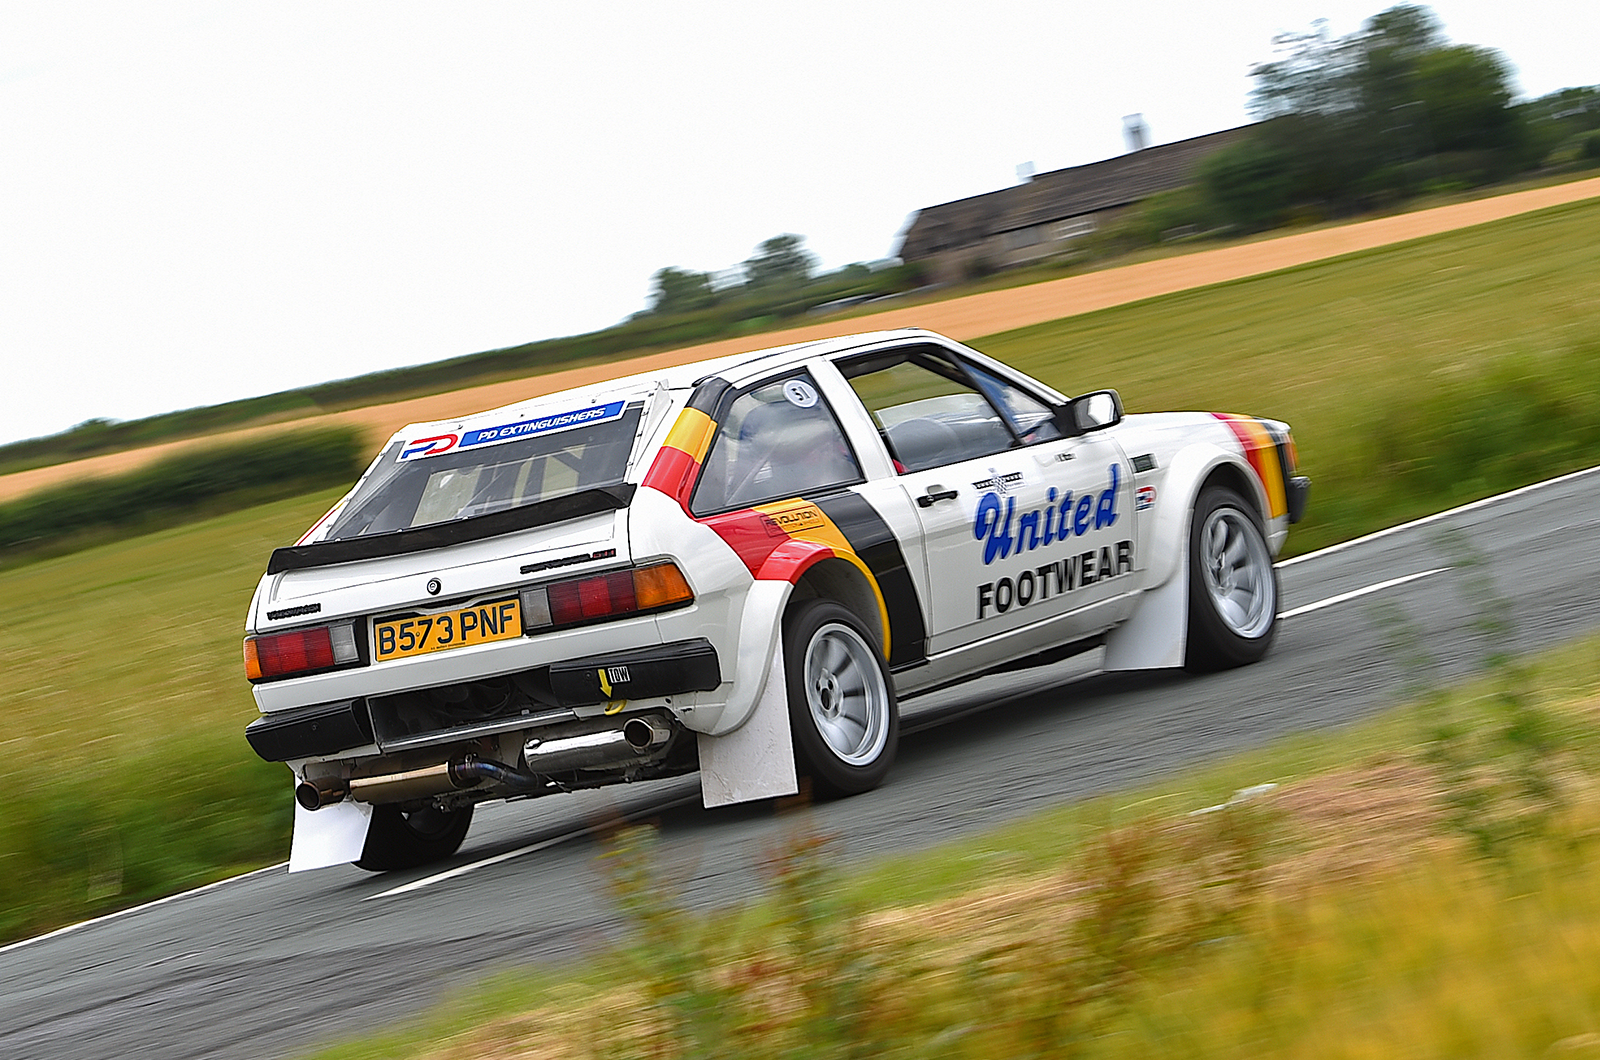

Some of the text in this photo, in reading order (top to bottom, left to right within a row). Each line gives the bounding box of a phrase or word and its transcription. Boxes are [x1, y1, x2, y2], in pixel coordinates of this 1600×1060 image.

[477, 407, 607, 442] PD EXTINGUISHERS
[763, 510, 818, 526] REVOLUTION
[974, 463, 1121, 566] United
[976, 540, 1135, 619] FOOTWEAR
[378, 602, 516, 656] B573 PNF
[608, 666, 631, 684] TOW
